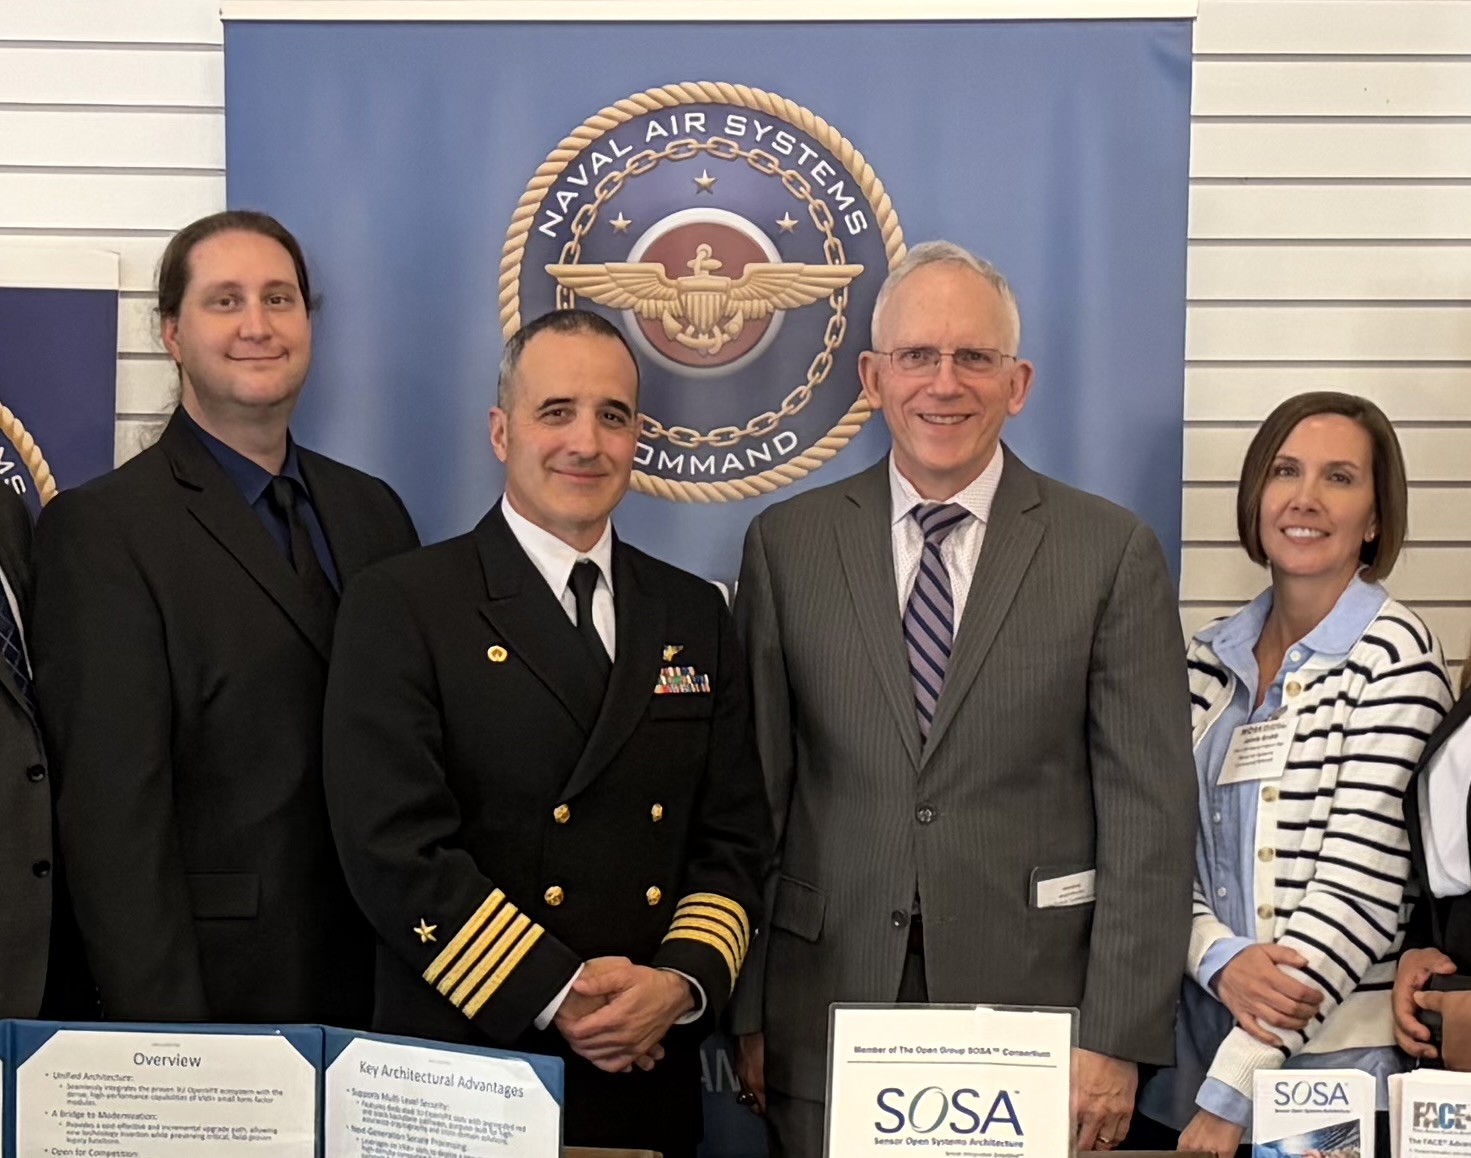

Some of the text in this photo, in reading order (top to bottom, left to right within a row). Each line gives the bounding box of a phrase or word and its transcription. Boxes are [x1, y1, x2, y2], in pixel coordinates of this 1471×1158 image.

[538, 112, 868, 238] NAVAL AIR SYSTEMS
[132, 1052, 202, 1068] Overview
[853, 1045, 886, 1055] Member
[889, 1046, 898, 1055] of
[899, 1046, 914, 1055] The
[916, 1046, 938, 1056] Open
[940, 1047, 966, 1056] Group
[1002, 1048, 1051, 1058] Consortium
[360, 1060, 524, 1099] Key Architectural Advantages
[1274, 1080, 1350, 1106] SOSA
[874, 1137, 1024, 1148] Sensor Open Systems Architecture
